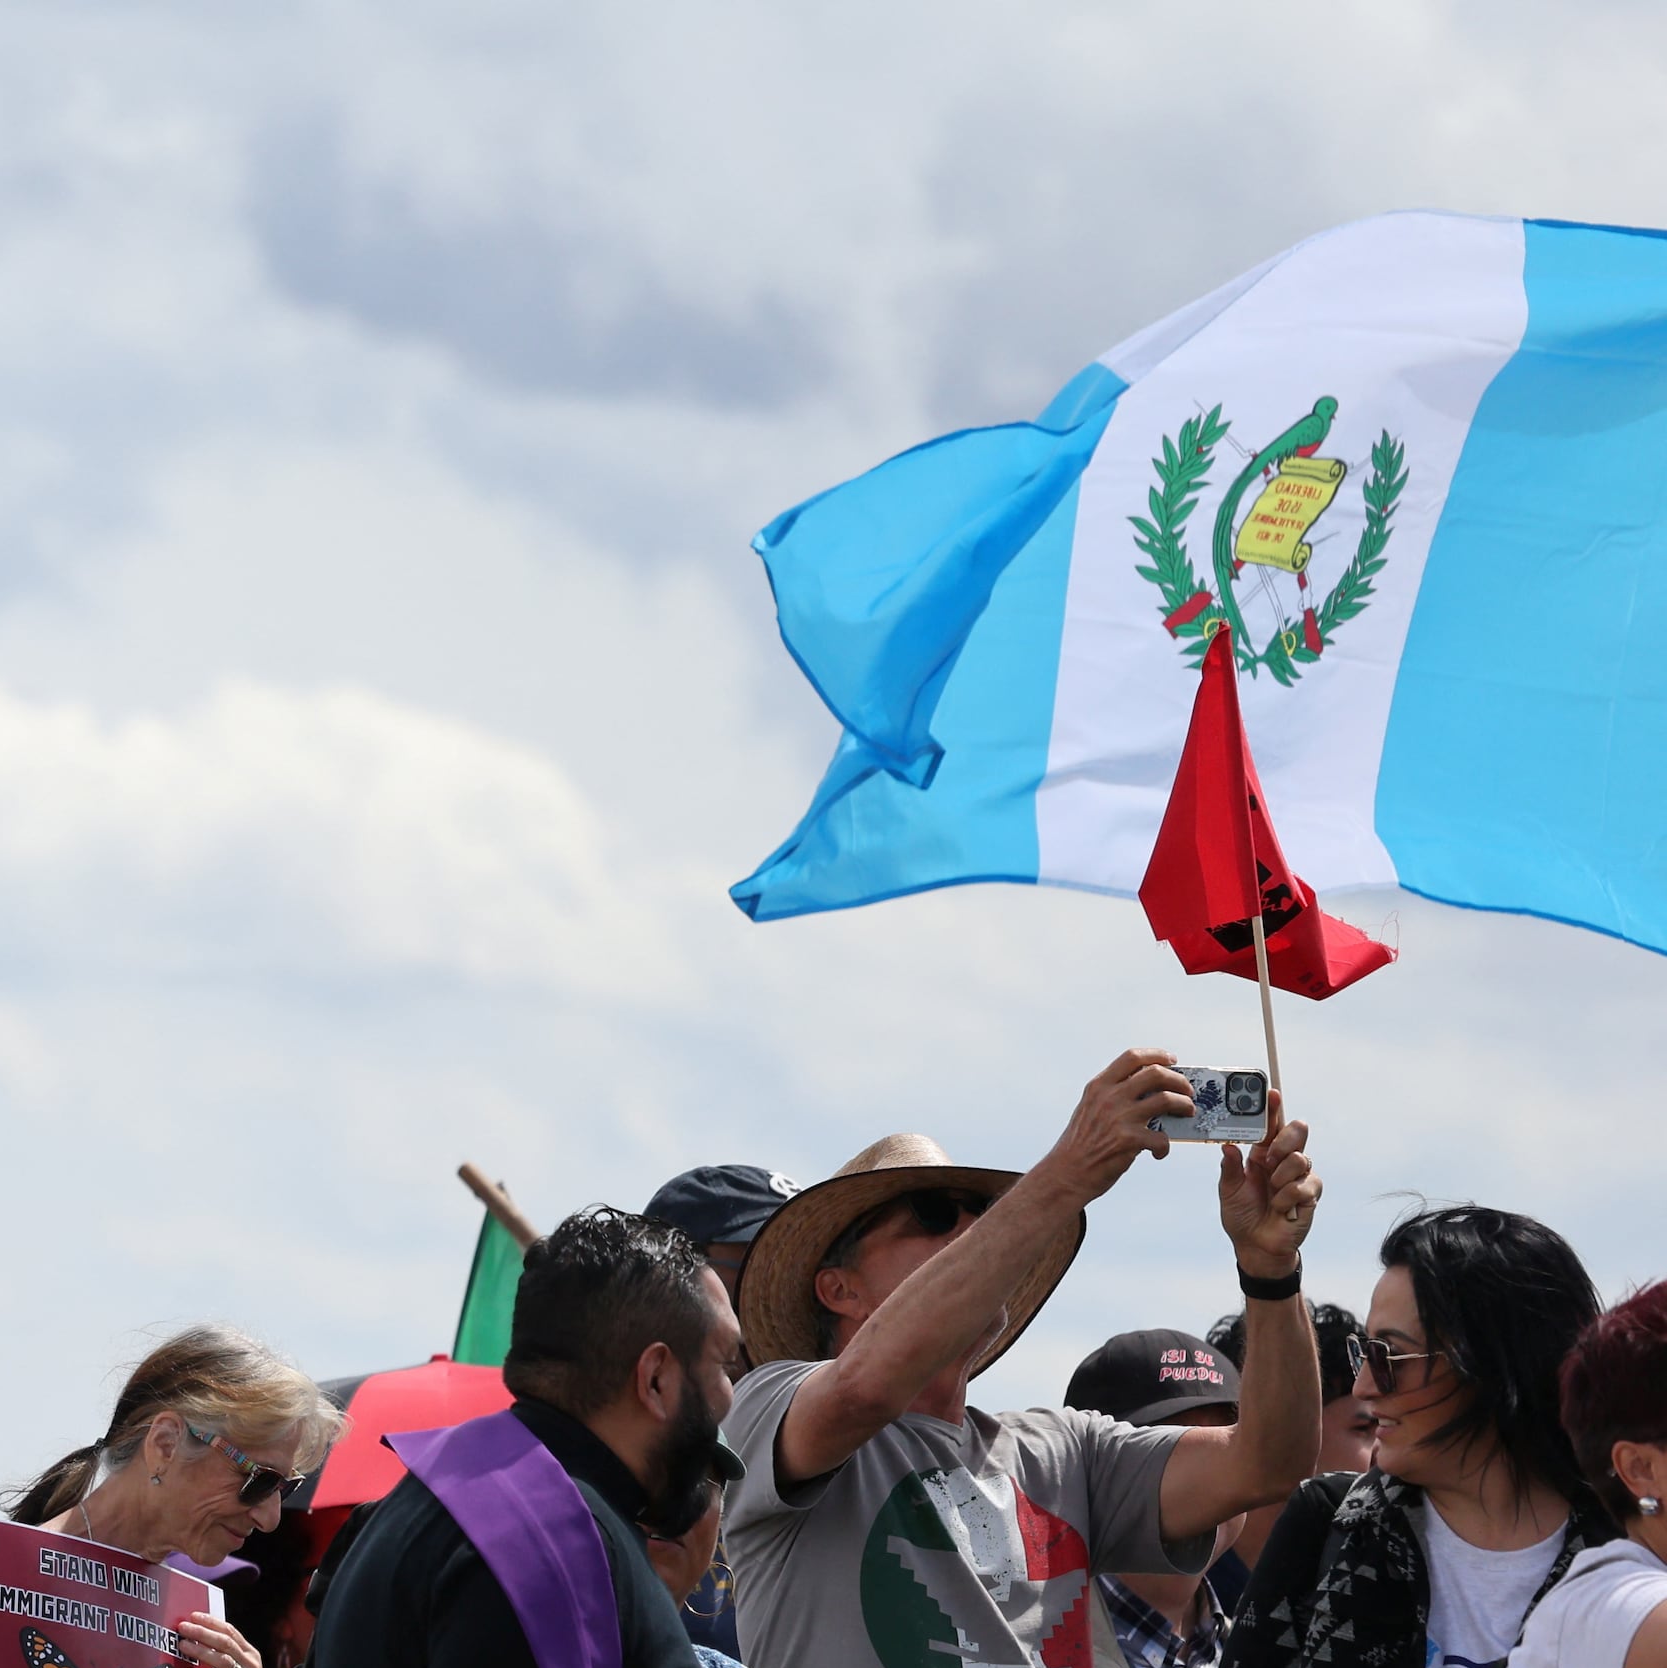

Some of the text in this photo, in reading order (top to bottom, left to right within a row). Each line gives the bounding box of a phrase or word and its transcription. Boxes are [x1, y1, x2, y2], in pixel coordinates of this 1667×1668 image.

[1194, 1350, 1215, 1367] SE
[1159, 1366, 1224, 1385] PUEDE!
[39, 1547, 160, 1606] STAND WITH
